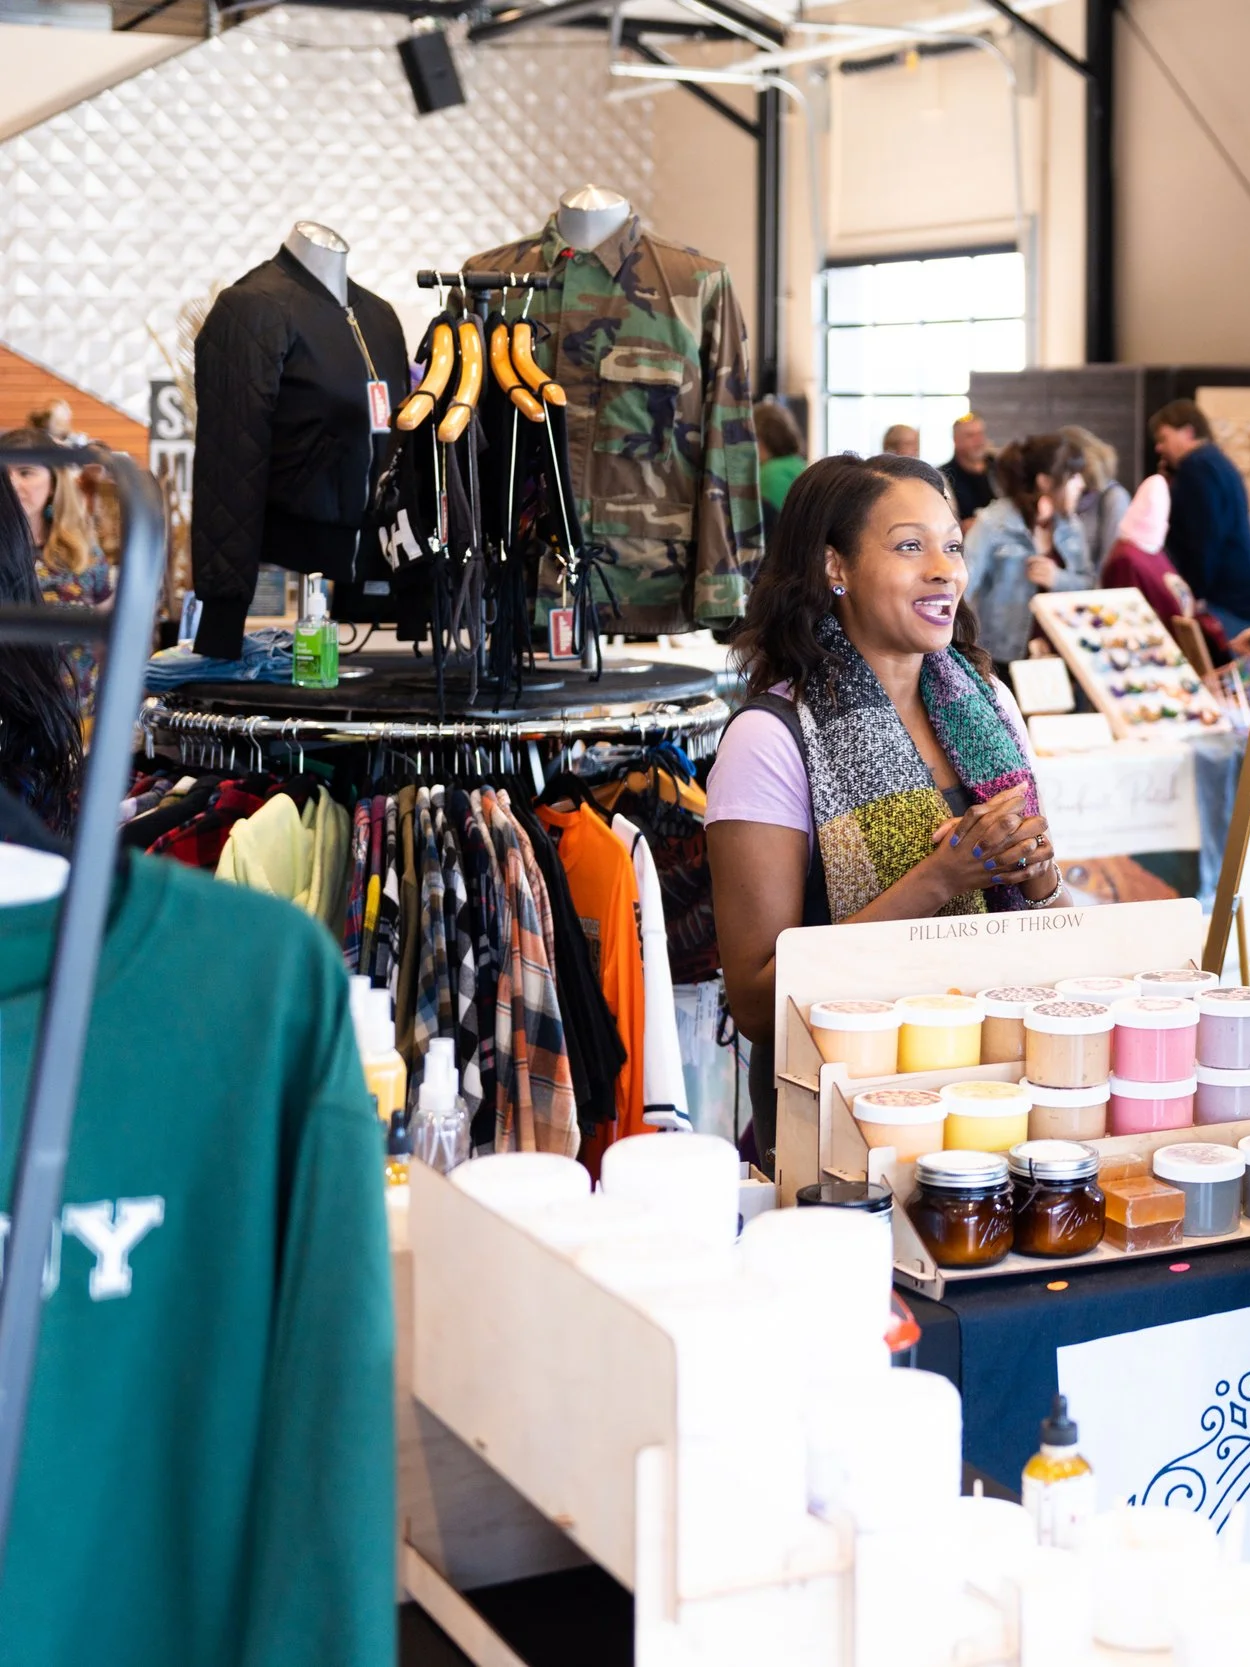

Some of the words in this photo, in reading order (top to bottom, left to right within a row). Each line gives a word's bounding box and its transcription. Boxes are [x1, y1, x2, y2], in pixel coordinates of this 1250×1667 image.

[909, 921, 979, 941] PILLARS
[986, 918, 1010, 935] OF
[1016, 912, 1084, 933] THROW
